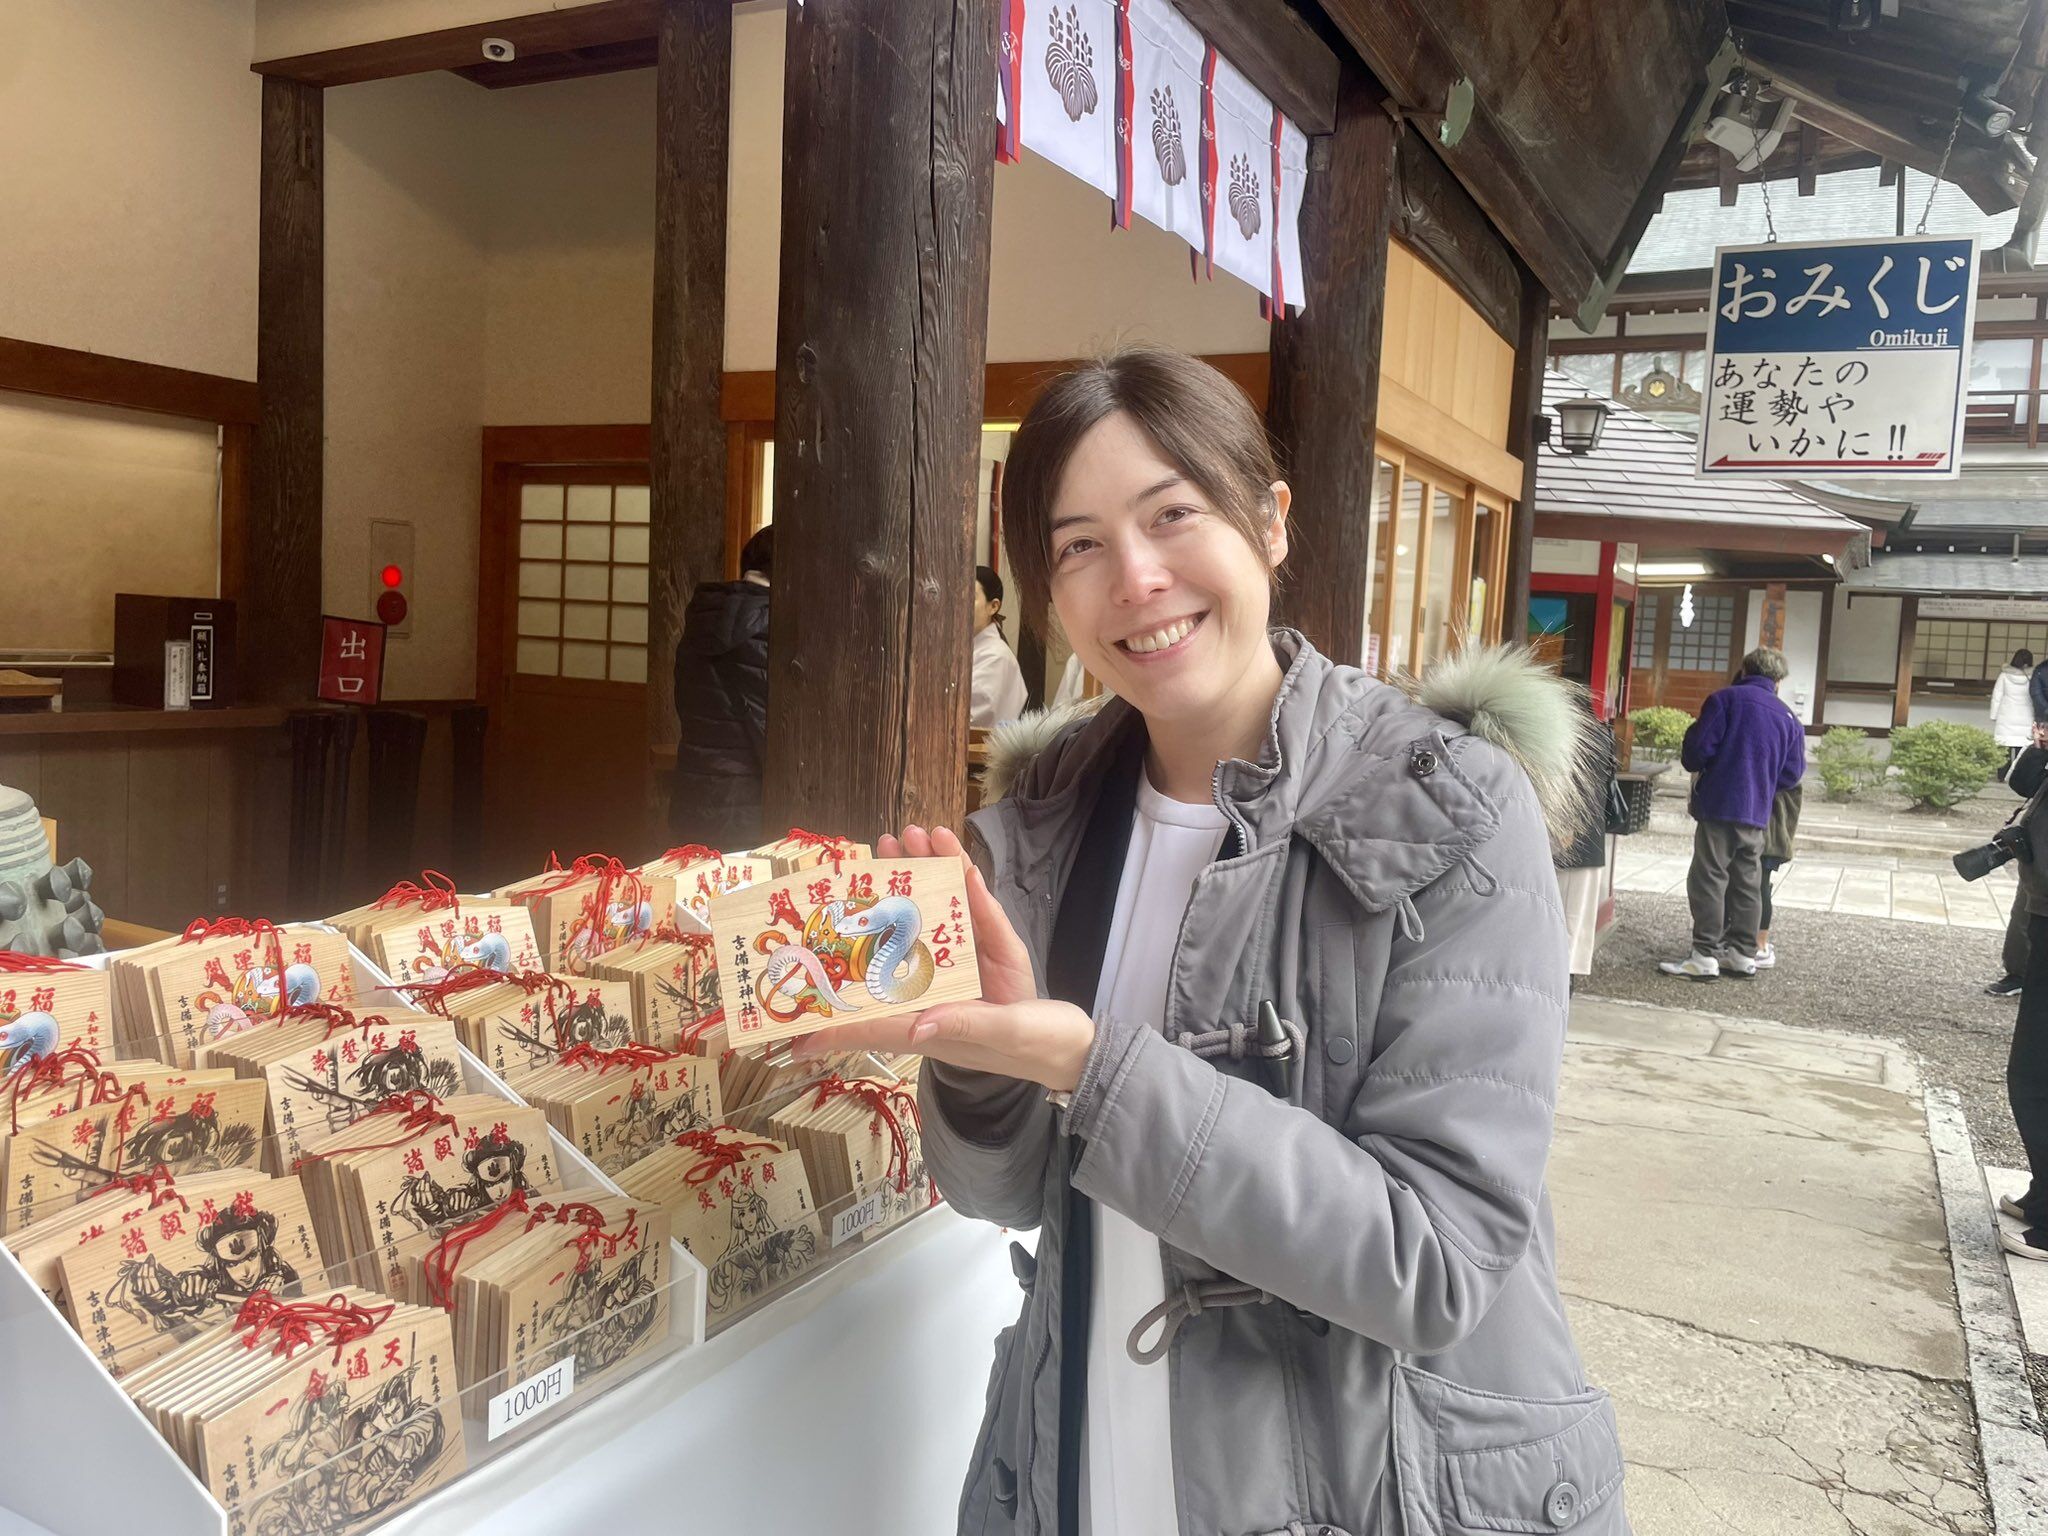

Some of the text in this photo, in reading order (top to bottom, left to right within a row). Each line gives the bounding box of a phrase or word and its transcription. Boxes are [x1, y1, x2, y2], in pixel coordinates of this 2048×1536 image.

[1720, 256, 1965, 323] おみくじ
[1870, 328, 1948, 348] Omikuji
[1714, 356, 1869, 389] あなたの
[1719, 390, 1854, 425] 運勢や
[338, 630, 366, 693] 出口
[768, 870, 912, 930] 開運招福
[949, 896, 966, 948] 令和七年
[732, 935, 757, 1018] 吉備津神社
[840, 1199, 875, 1236] 1000円
[504, 1368, 562, 1423] 1000円
